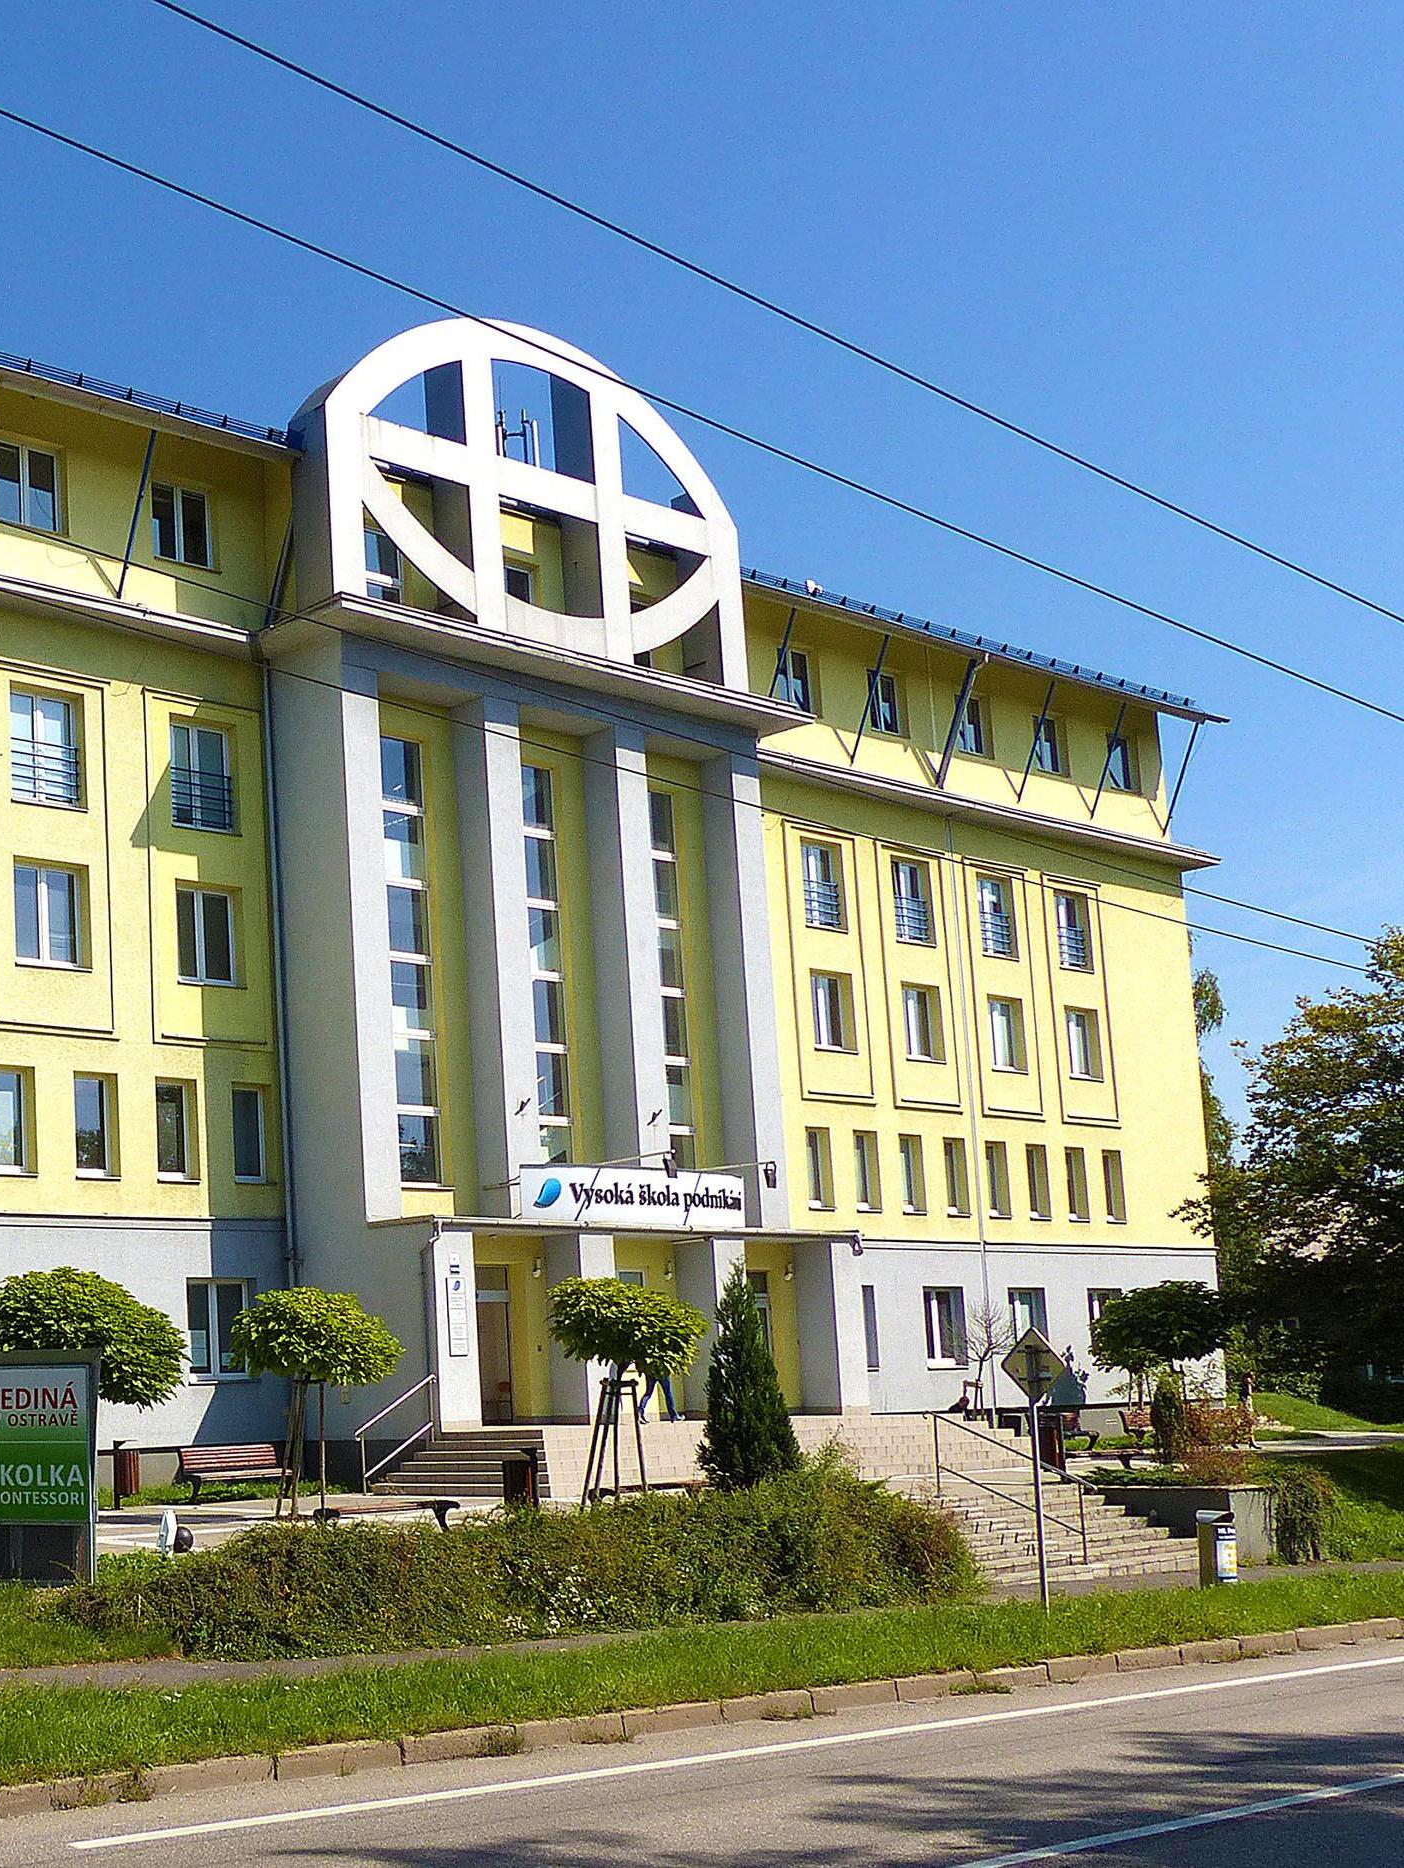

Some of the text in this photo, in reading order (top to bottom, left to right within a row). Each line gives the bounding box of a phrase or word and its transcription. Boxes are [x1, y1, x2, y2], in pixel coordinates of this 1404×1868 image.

[569, 1182, 634, 1210] Vysoká
[638, 1183, 680, 1206] škola
[7, 1409, 78, 1427] OSTRAVĚ
